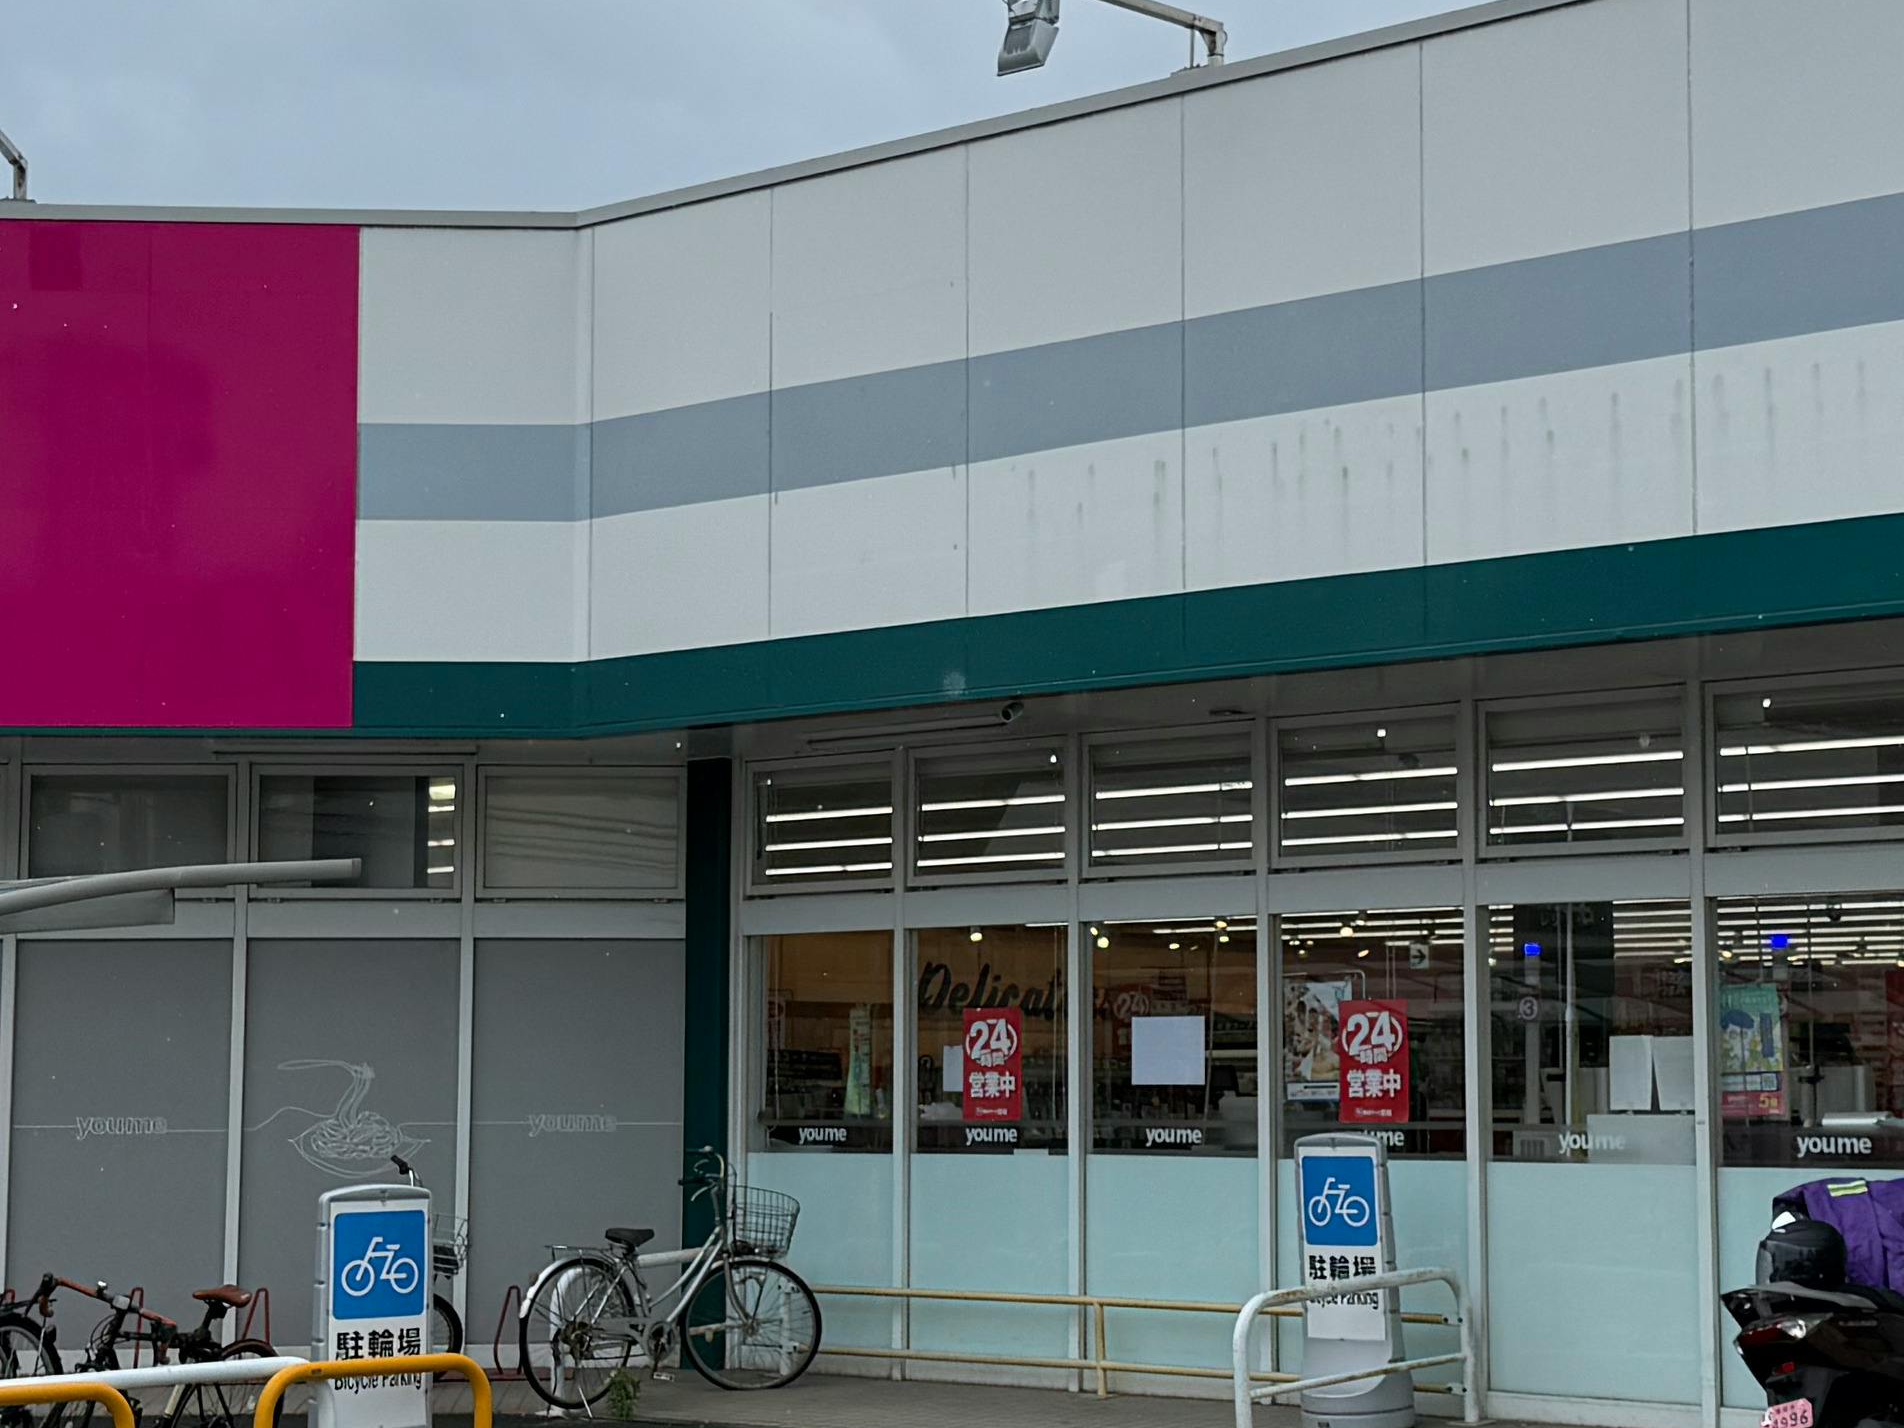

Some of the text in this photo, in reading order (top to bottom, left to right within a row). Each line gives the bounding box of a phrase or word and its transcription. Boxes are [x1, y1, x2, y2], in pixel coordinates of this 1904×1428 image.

[969, 1018, 1011, 1060] 24
[1346, 1011, 1396, 1056] 24
[969, 1071, 1016, 1098] 営業中
[1347, 1069, 1401, 1098] 営業中
[798, 1126, 847, 1144] youme
[965, 1127, 1018, 1146] youme
[1145, 1127, 1203, 1147] youme
[1558, 1130, 1626, 1154] youme
[1796, 1136, 1873, 1158] youme
[1309, 1255, 1377, 1281] 駐輪場
[336, 1328, 421, 1360] 駐輪場
